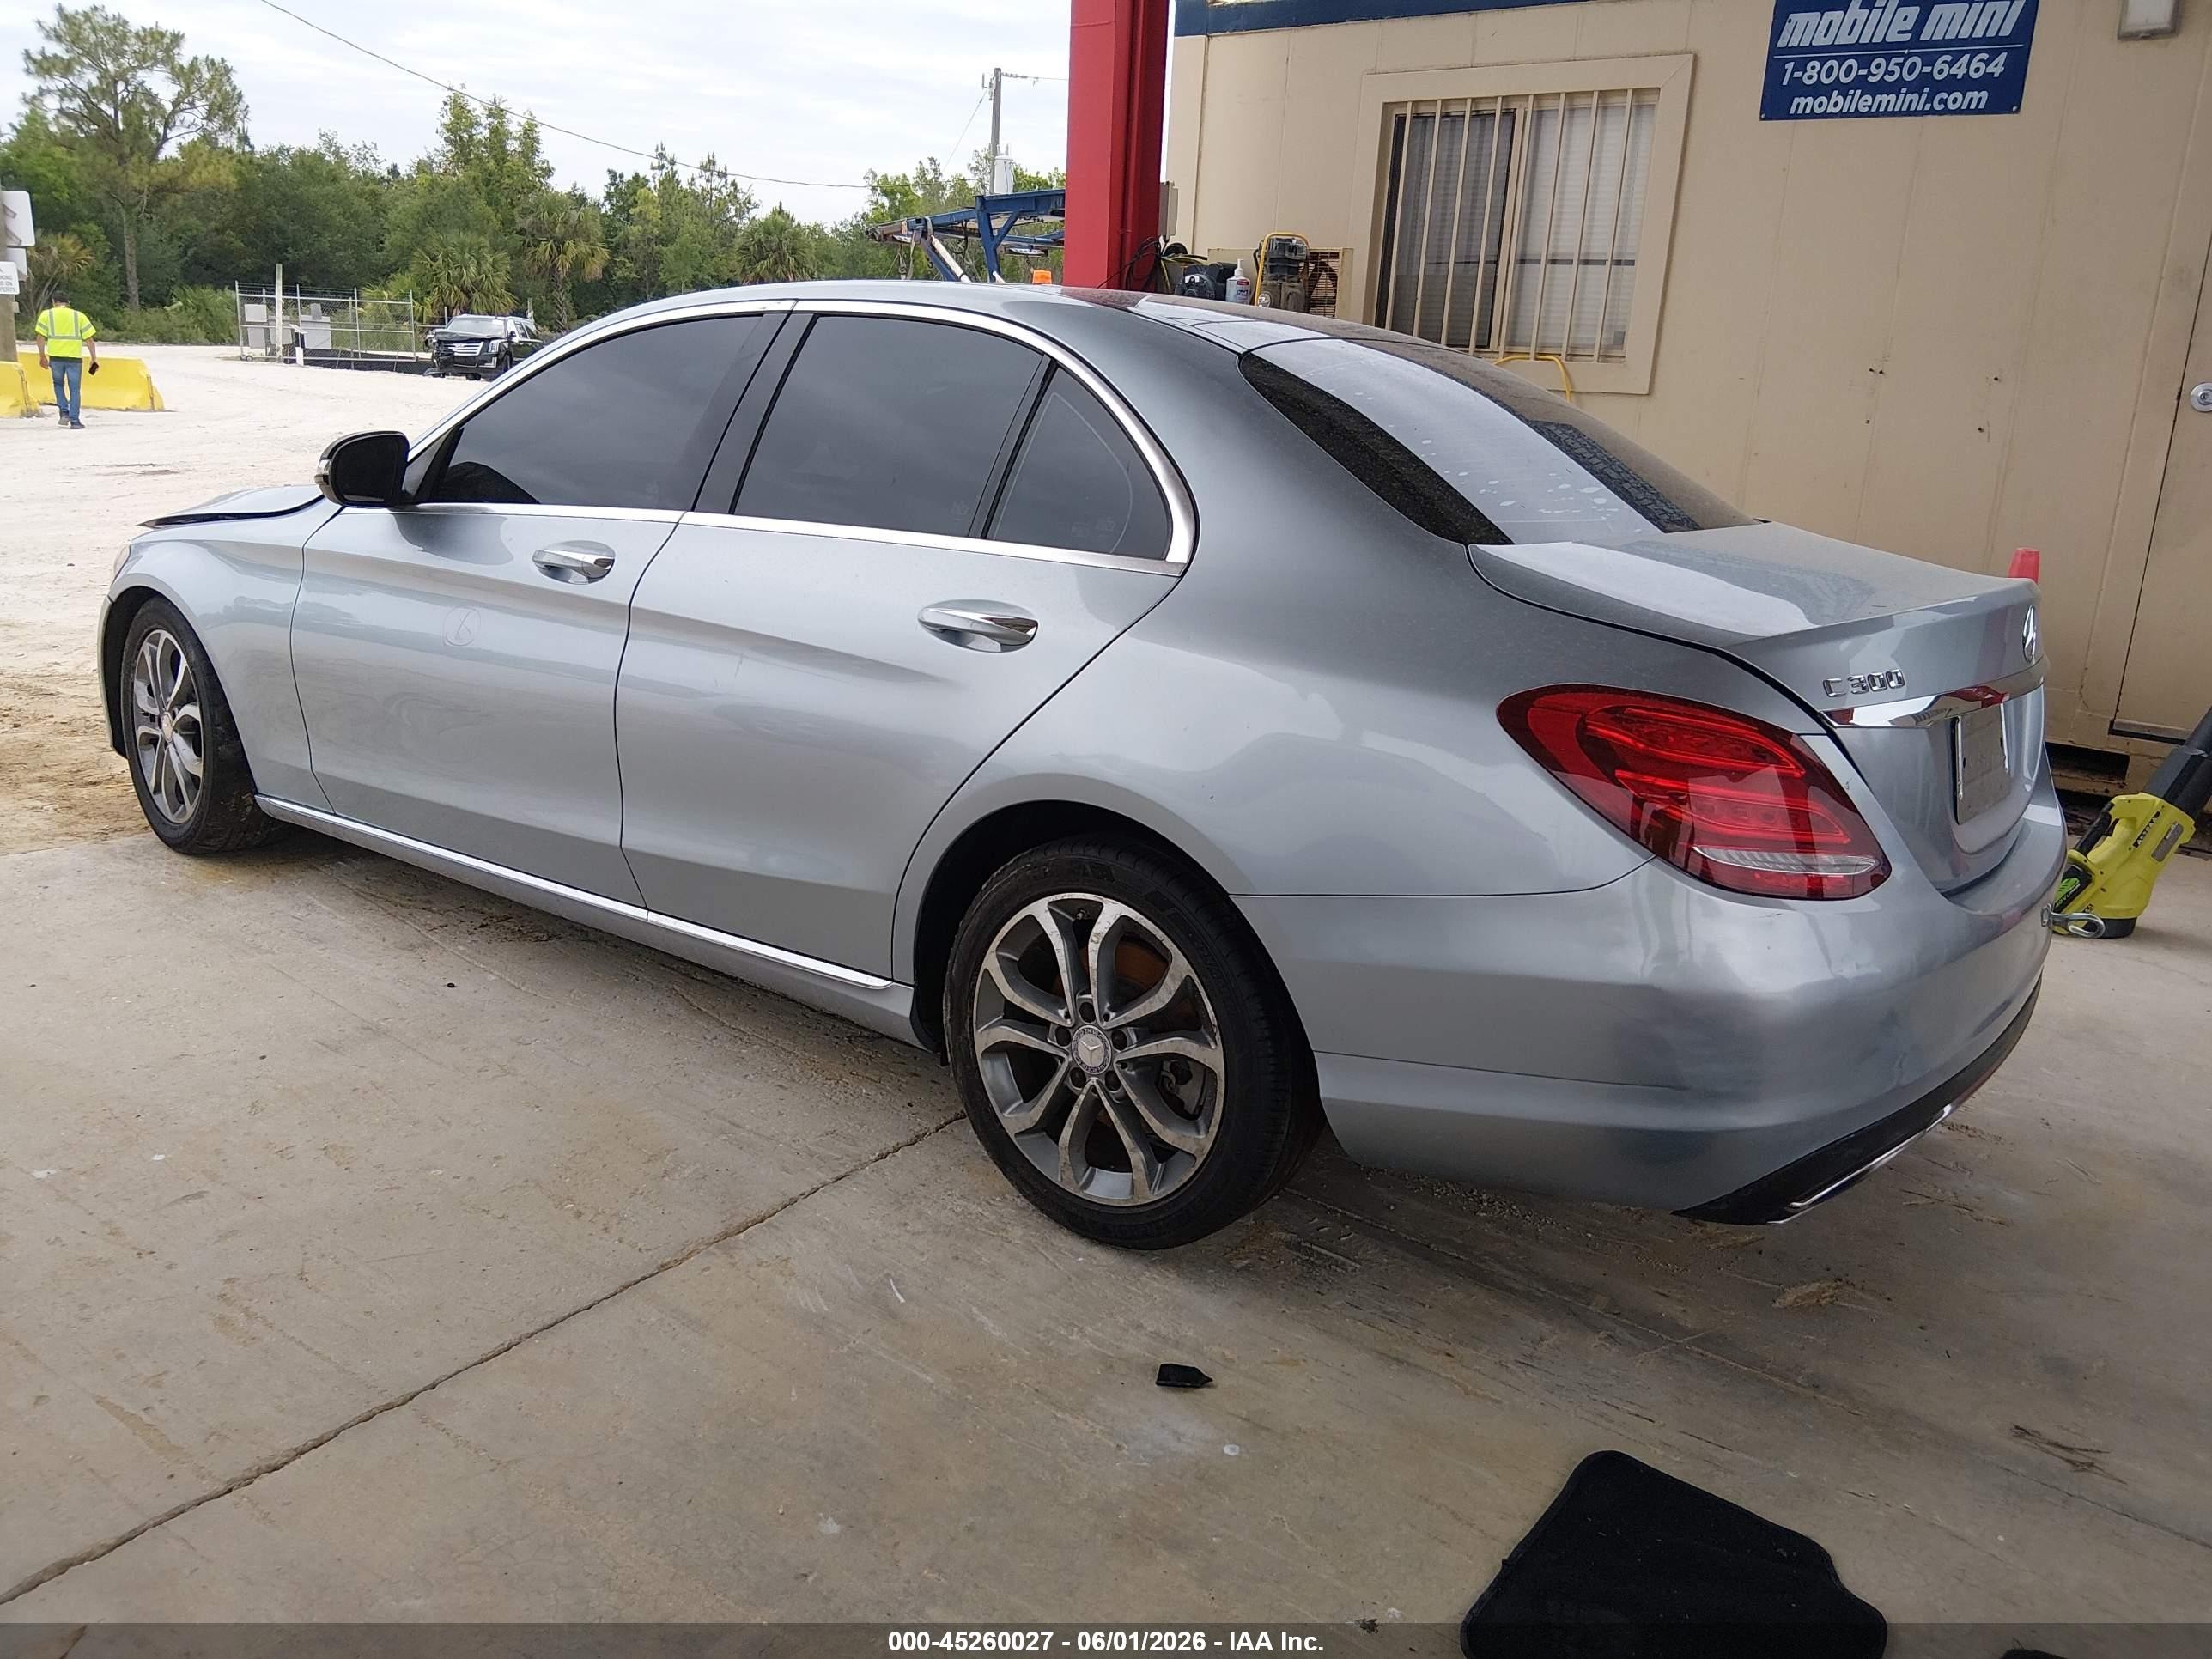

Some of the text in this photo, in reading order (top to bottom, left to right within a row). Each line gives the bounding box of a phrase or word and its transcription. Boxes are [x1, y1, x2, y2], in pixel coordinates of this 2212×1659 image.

[1776, 0, 2026, 47] mobile mini
[1782, 52, 2008, 86] 1-800-950-6464
[1789, 87, 1989, 115] mobilemini.com
[1822, 669, 1905, 697] C 300
